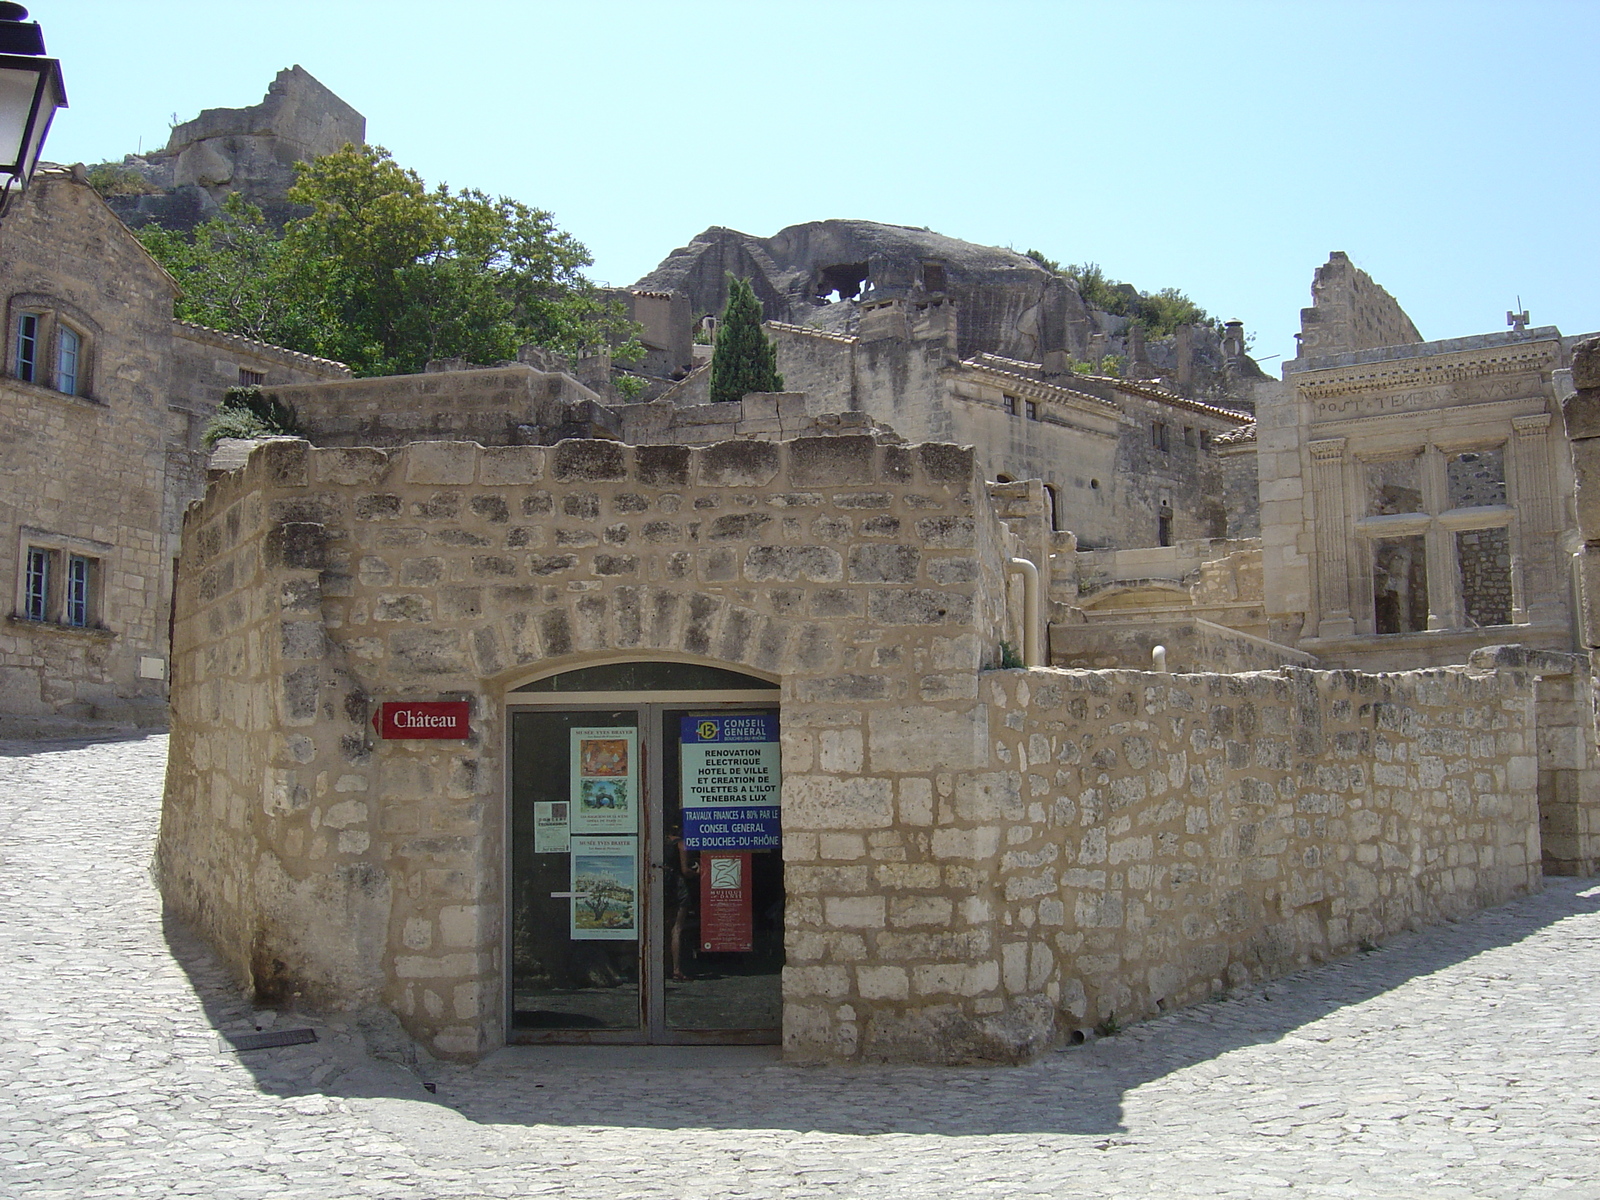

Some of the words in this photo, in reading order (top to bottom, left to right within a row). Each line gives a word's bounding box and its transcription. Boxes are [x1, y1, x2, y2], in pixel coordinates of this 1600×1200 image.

[1318, 397, 1364, 417] POST
[394, 711, 456, 728] Château
[724, 719, 765, 728] CONSEIL
[703, 724, 714, 738] 13
[724, 728, 766, 736] GENERAL
[705, 749, 761, 757] RENOVATION
[706, 758, 761, 766] ELECTRIQUE
[698, 768, 727, 776] HOTEL
[729, 767, 741, 775] DE
[743, 767, 769, 775] VILLE
[697, 777, 709, 785] ET
[711, 776, 755, 784] CREATION
[757, 776, 770, 784] DE
[691, 786, 738, 794] TOILETTES
[749, 785, 776, 793] L'ILOT
[700, 795, 747, 803] TENEBRAS
[749, 794, 767, 802] LUX
[685, 811, 713, 821] TRAVAUX
[713, 810, 739, 820] FINANCES
[740, 810, 747, 820] A
[747, 810, 759, 820] 80%
[759, 810, 771, 819] PAR
[772, 809, 779, 819] LE
[699, 824, 730, 834] CONSEIL
[731, 823, 765, 833] GENERAL
[686, 837, 700, 847] DES
[702, 834, 779, 847] BOUCHES-DU-RHÔNE
